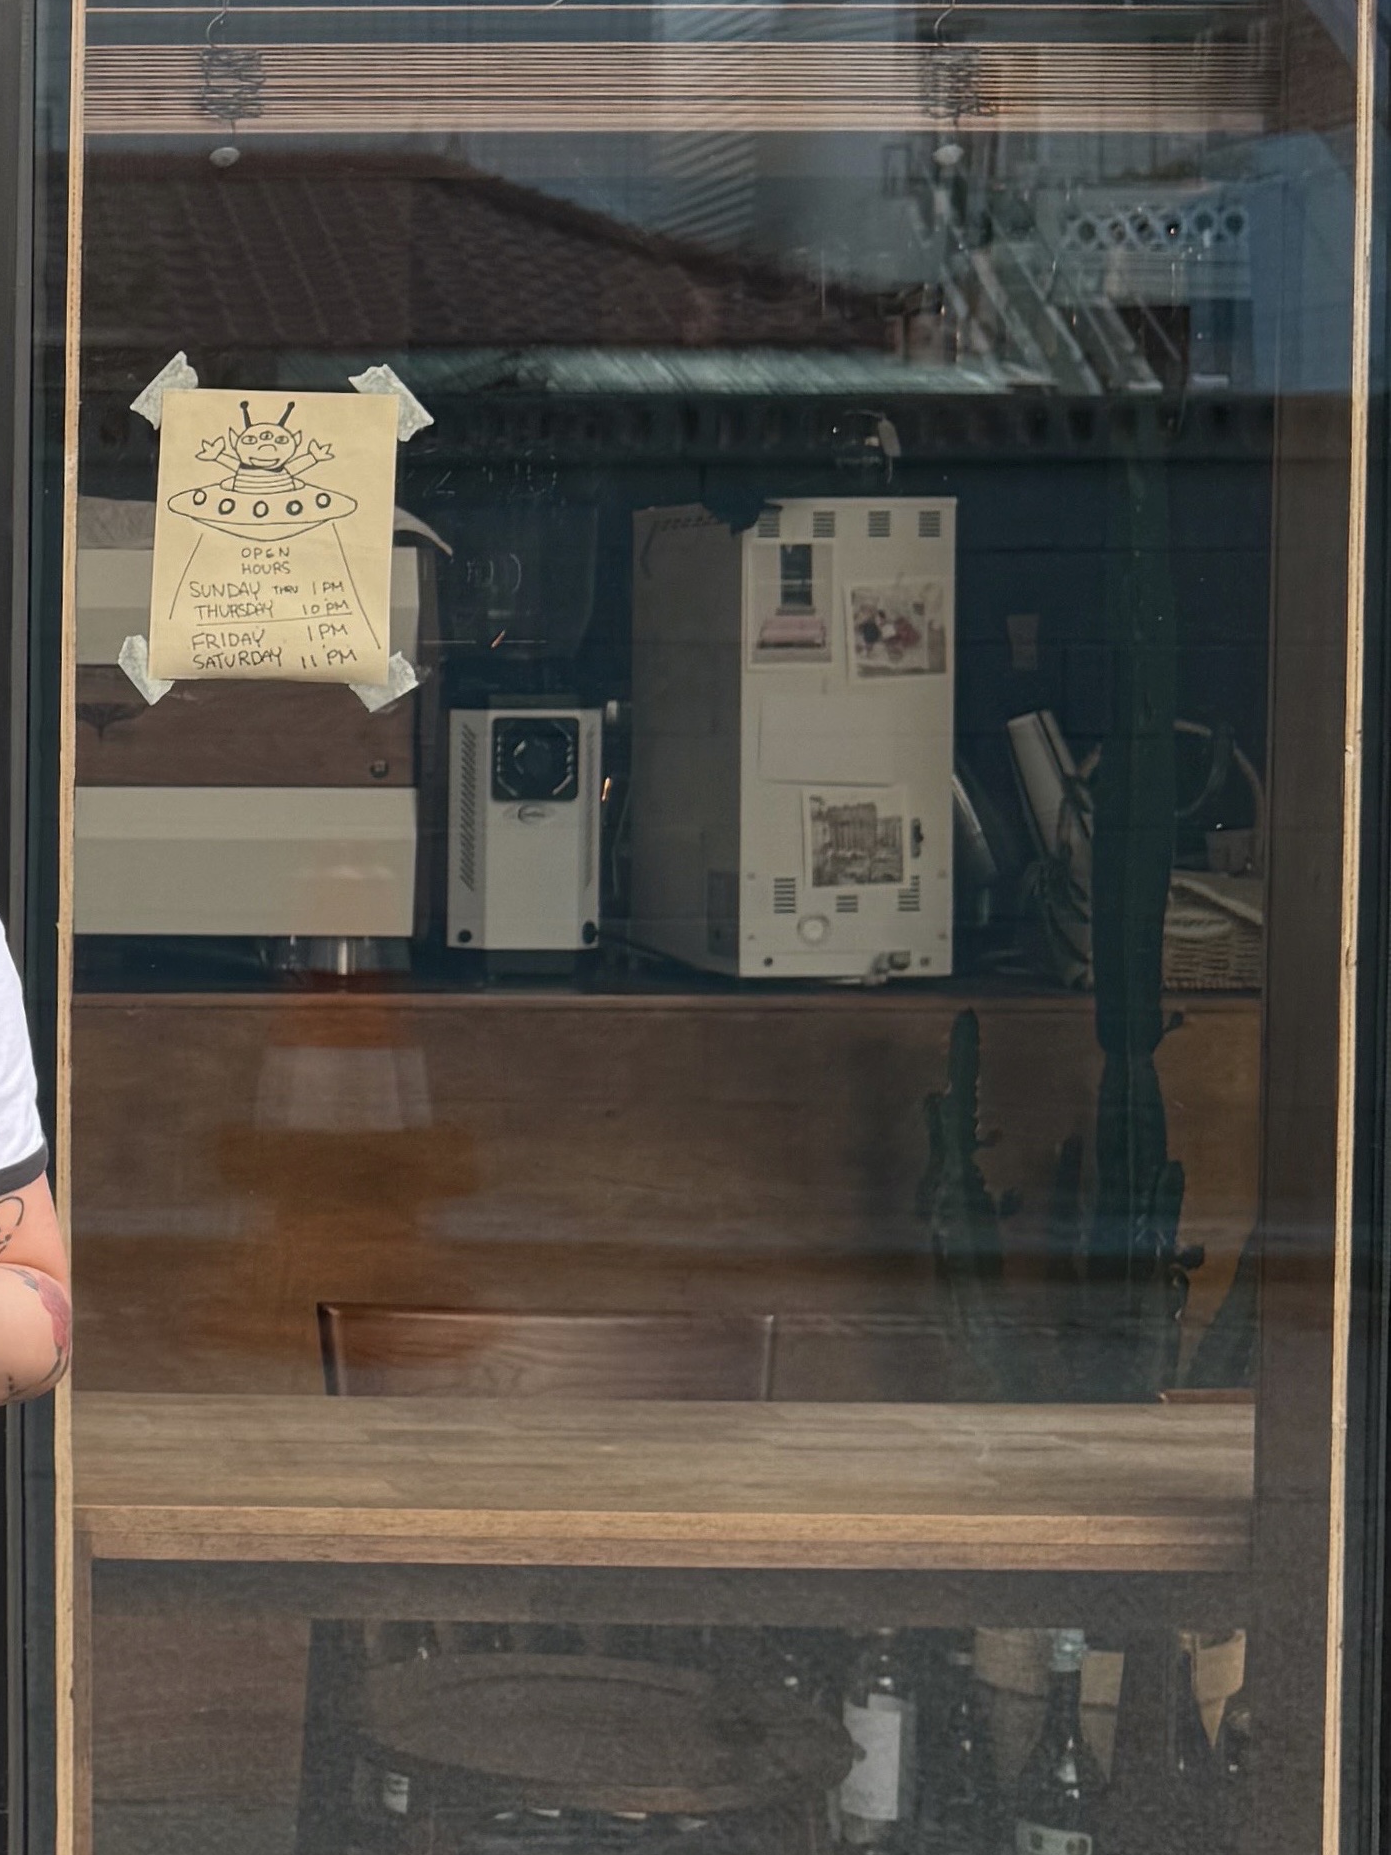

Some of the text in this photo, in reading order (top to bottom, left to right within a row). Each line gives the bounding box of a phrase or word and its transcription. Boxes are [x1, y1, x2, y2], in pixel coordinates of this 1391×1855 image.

[241, 546, 291, 559] OPEN
[241, 561, 292, 576] HOURS
[189, 580, 261, 602] SUNDAY
[273, 584, 299, 595] THRU
[322, 580, 345, 593] PM
[194, 600, 349, 620] THURSDAY 10 PM
[191, 629, 265, 651] FRIDAY
[319, 623, 349, 640] PM
[193, 647, 358, 670] SATURDAY 11 PM
